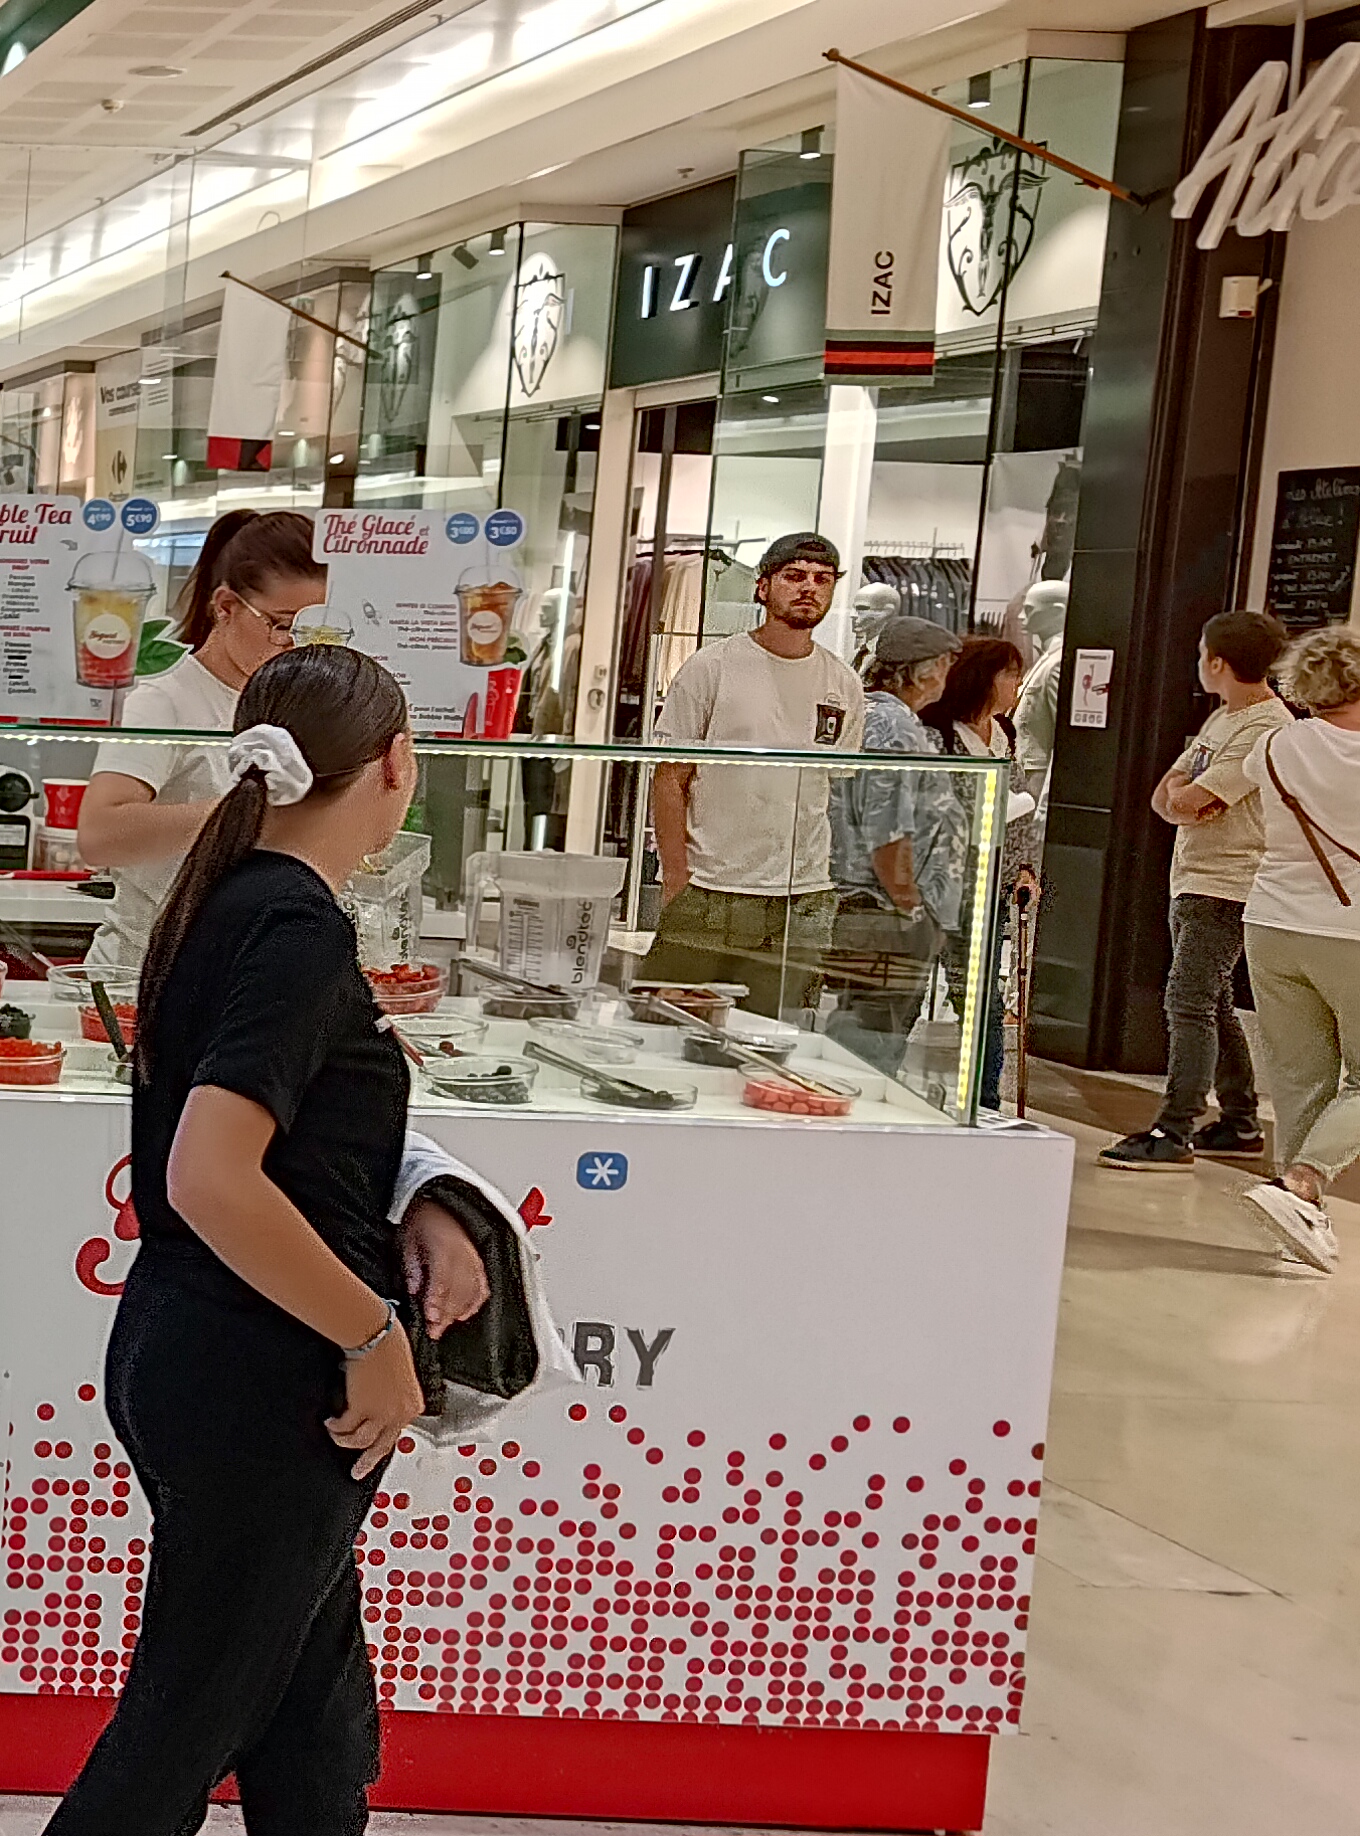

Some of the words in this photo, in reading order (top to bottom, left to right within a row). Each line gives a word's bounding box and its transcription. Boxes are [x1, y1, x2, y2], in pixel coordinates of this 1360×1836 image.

[871, 251, 894, 315] IZAC
[35, 503, 72, 525] Tea
[323, 514, 358, 536] Thé
[362, 513, 416, 540] Glacé
[323, 535, 429, 555] Citronnade
